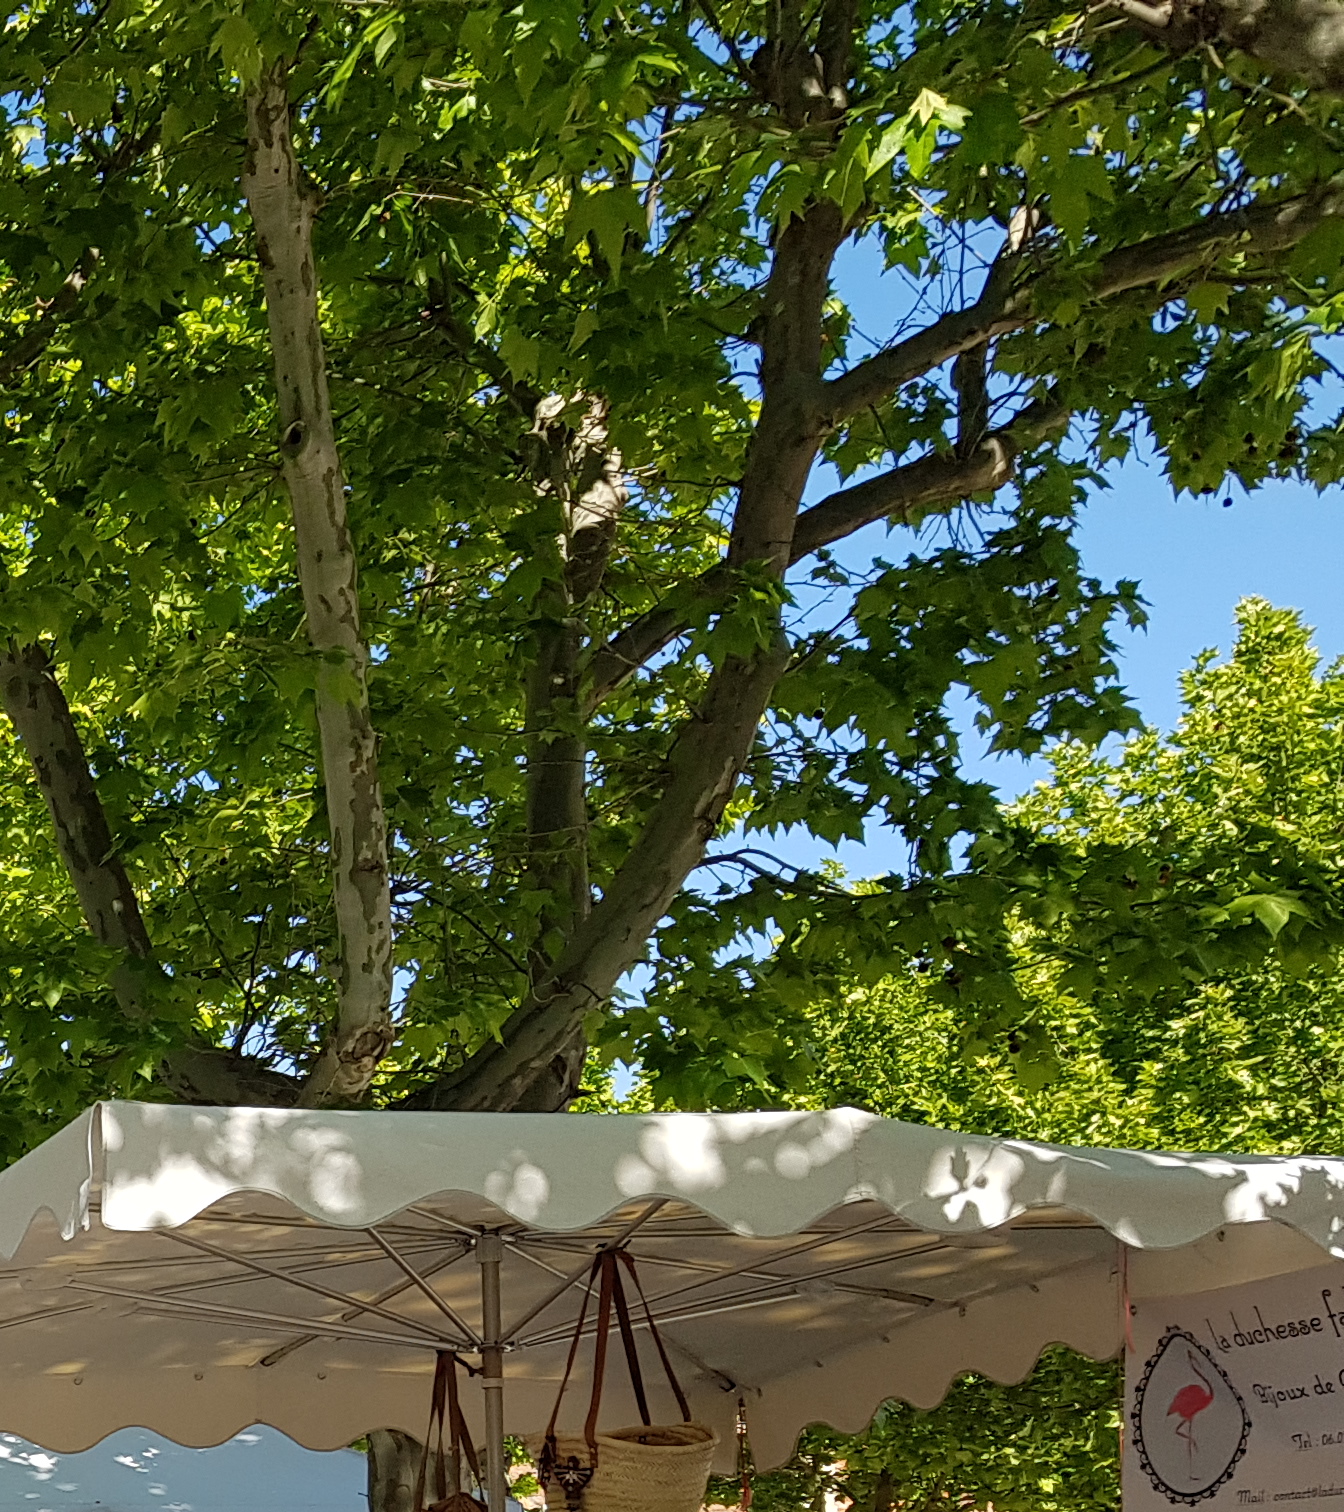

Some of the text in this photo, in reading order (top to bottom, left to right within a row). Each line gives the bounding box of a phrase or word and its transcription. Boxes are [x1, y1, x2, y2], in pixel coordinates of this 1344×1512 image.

[1205, 1318, 1231, 1354] la
[1229, 1305, 1324, 1348] duchesse
[1252, 1383, 1311, 1409] Bijoux
[1313, 1374, 1335, 1396] de
